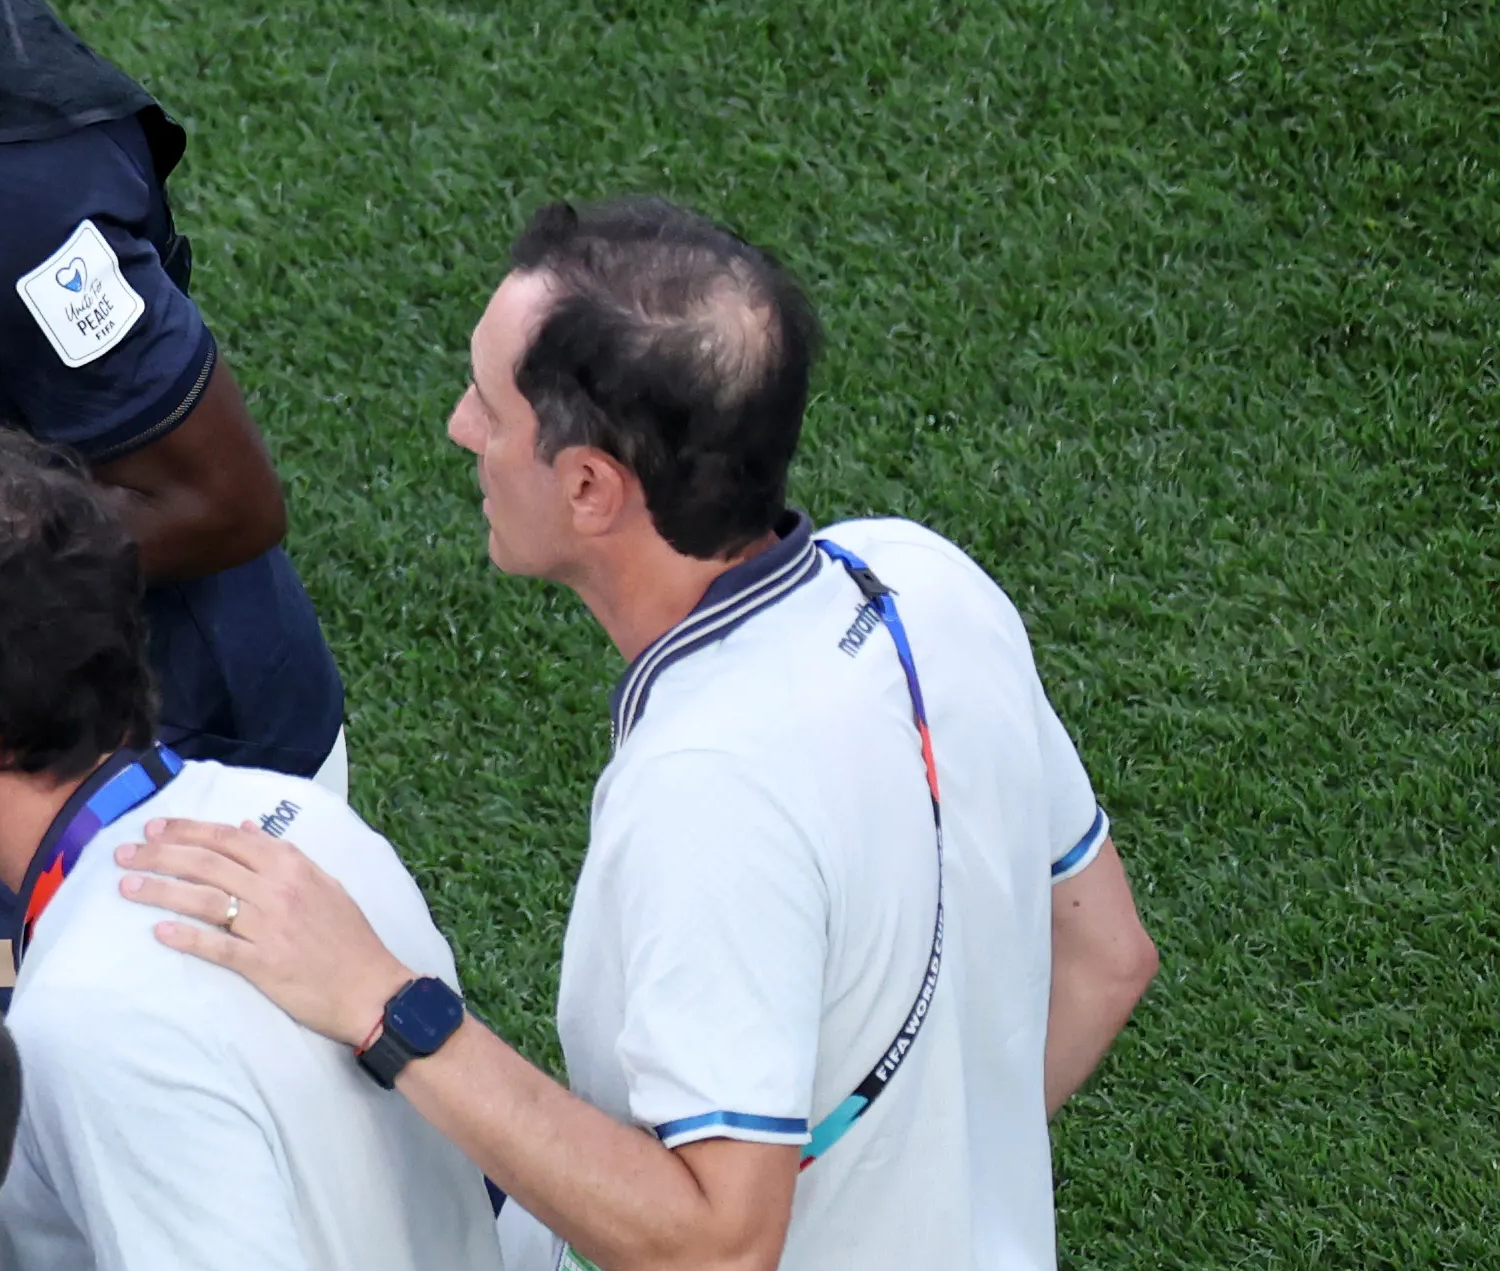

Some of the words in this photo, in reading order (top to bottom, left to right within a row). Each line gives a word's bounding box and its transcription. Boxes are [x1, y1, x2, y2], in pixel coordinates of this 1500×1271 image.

[77, 294, 115, 336] PEACE
[95, 320, 116, 341] FIFA
[875, 1037, 912, 1082] FIFA
[904, 957, 941, 1036] WORLD
